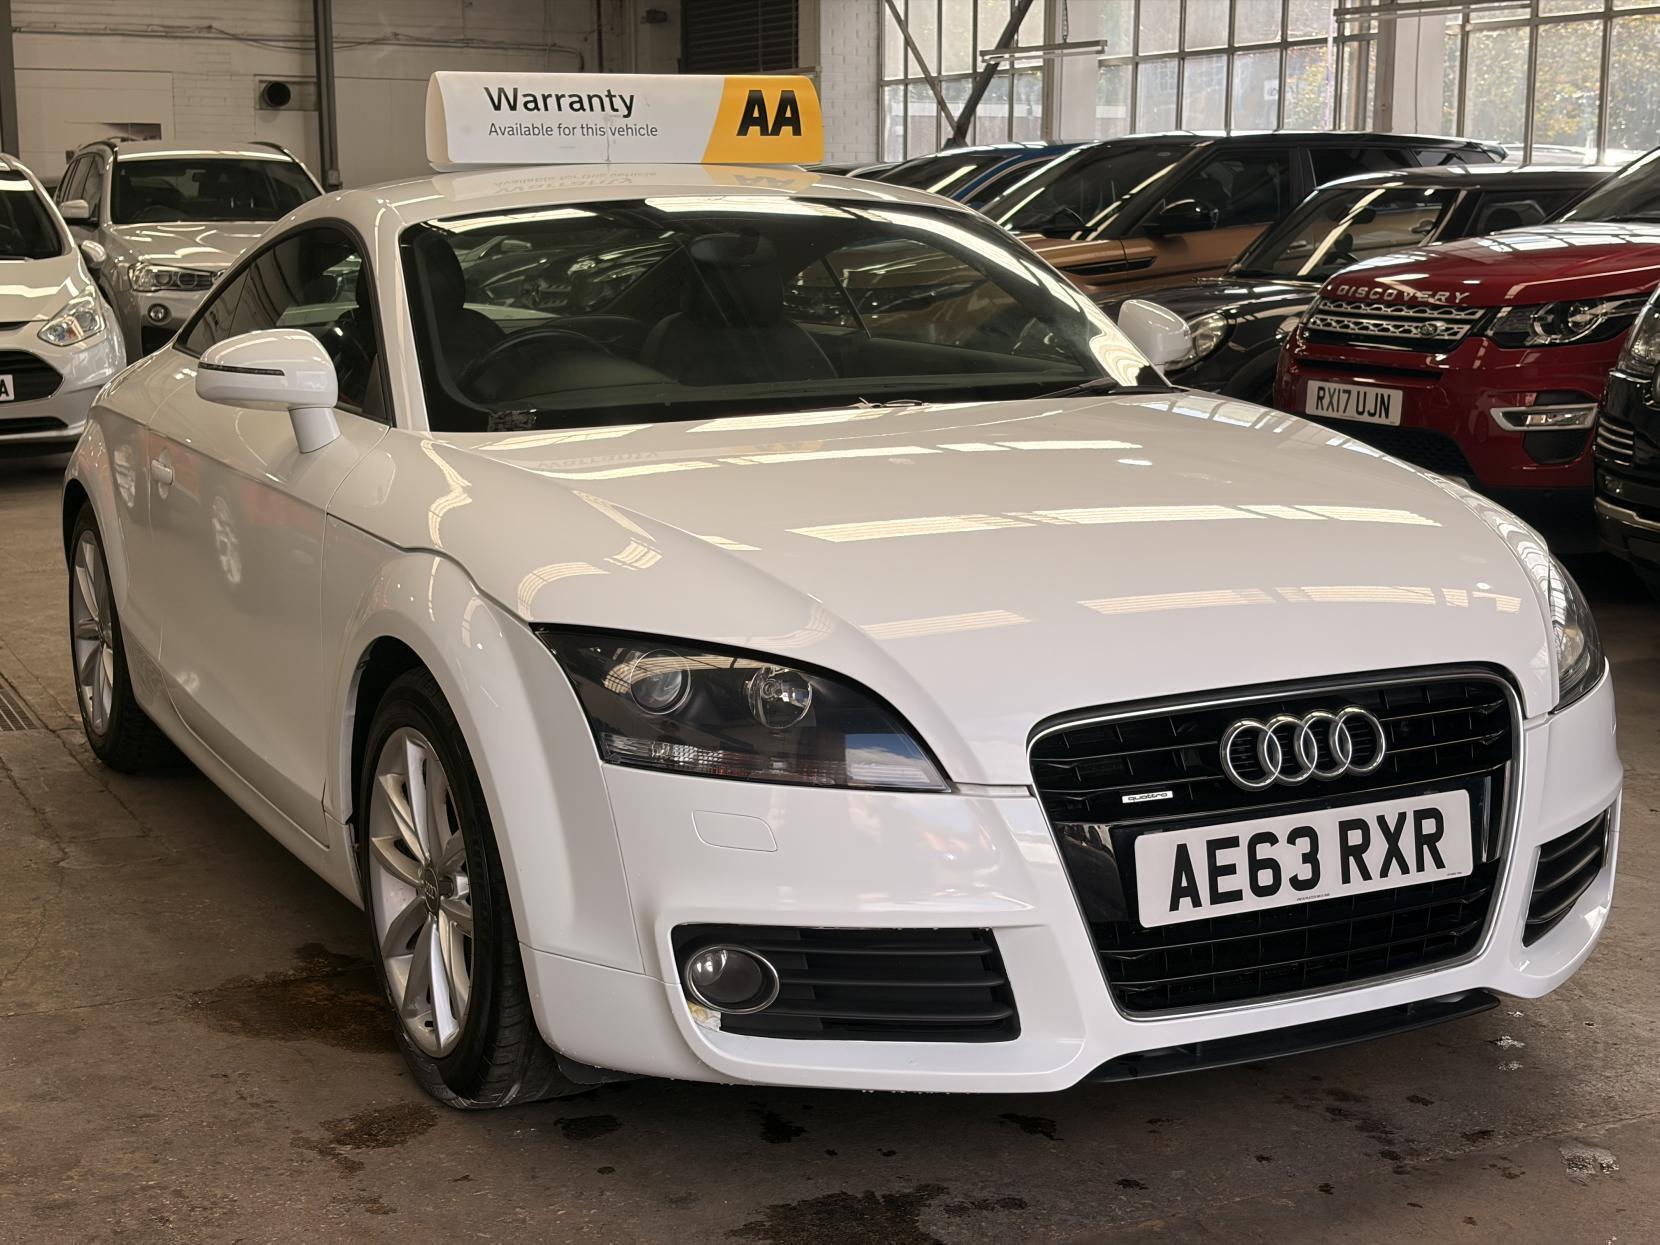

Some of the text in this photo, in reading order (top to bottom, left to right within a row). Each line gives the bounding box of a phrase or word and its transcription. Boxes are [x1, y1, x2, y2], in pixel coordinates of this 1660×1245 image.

[484, 86, 635, 119] Warranty
[736, 89, 802, 137] AA
[488, 122, 659, 137] Available for this vehicle
[1337, 285, 1470, 304] DISCOVERY
[1315, 386, 1391, 420] RX17 UJN
[1128, 792, 1168, 803] quattro
[1168, 807, 1447, 913] AE63 RXR
